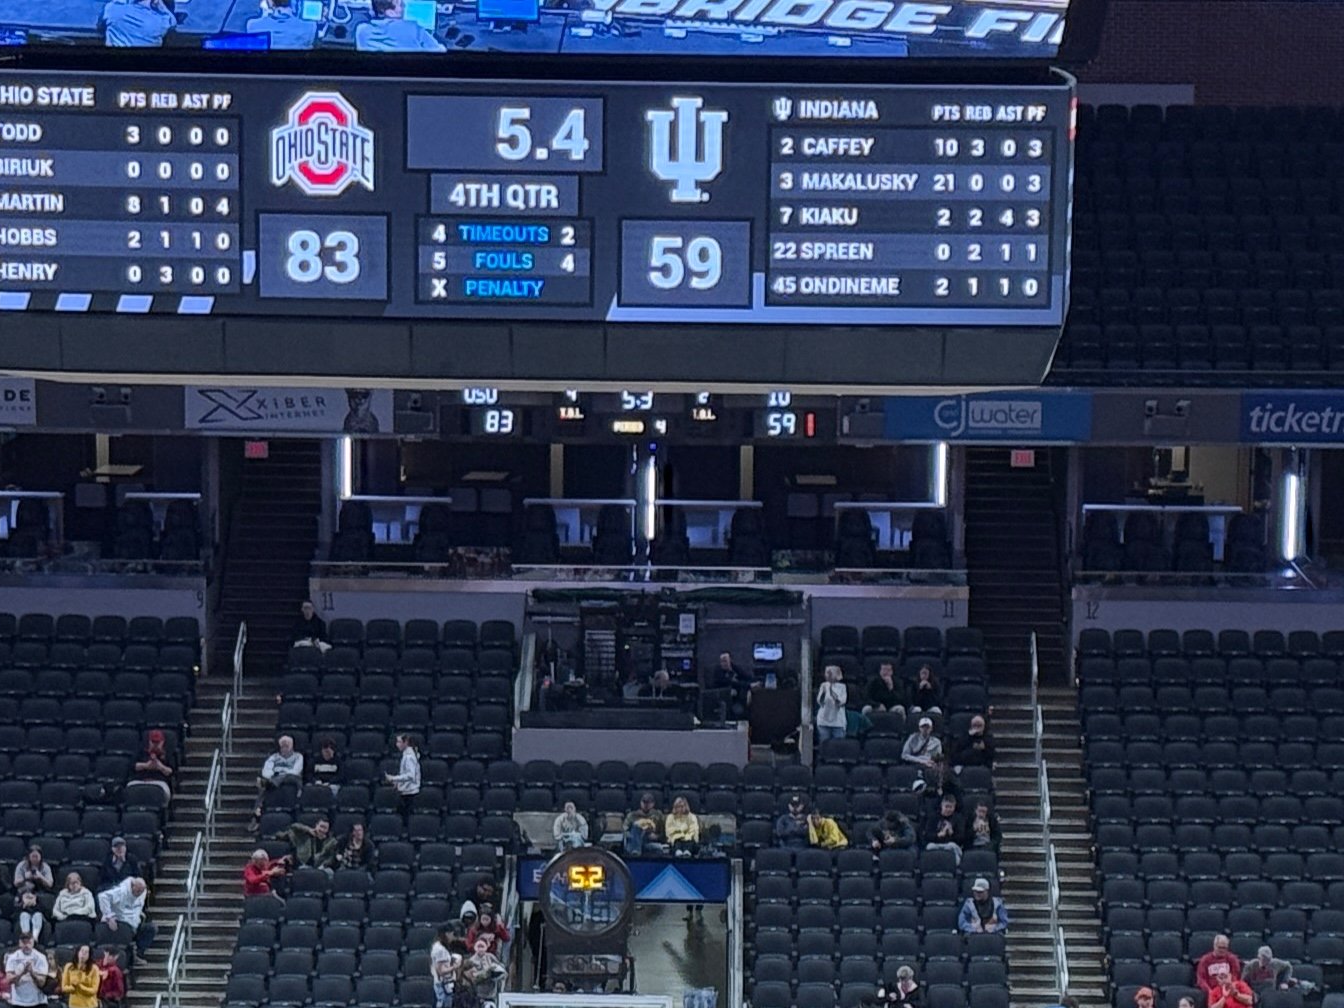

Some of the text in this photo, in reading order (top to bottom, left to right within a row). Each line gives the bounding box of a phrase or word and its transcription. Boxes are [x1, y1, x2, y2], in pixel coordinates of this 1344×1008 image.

[37, 87, 95, 106] STATE
[119, 91, 147, 109] PTS
[151, 92, 178, 109] REB
[181, 93, 210, 110] AST
[212, 93, 232, 110] PF
[799, 101, 1047, 122] INDIANA PTS REB AST PF
[126, 127, 140, 144] 3
[158, 127, 172, 144] 0
[189, 127, 203, 144] 0
[215, 127, 229, 144] 0
[496, 107, 589, 160] 5.4
[780, 138, 1042, 158] 2 CAFFEY 10 3 0 3
[127, 160, 141, 179] 0
[159, 160, 172, 179] 0
[190, 160, 204, 179] 0
[216, 160, 230, 179] 0
[779, 172, 1041, 193] 3 MAKALUSKY 21 0 0 3
[127, 196, 141, 215] 8
[159, 196, 171, 215] 1
[190, 196, 204, 215] 0
[215, 196, 230, 215] 4
[449, 183, 559, 210] 4TH QTR
[780, 207, 1041, 227] 7 KIAKU 2 2 4 3
[127, 231, 142, 249] 2
[159, 231, 171, 249] 1
[191, 231, 202, 249] 1
[217, 231, 230, 249] 0
[432, 224, 575, 245] 4 TIMEOUTS 2
[287, 230, 360, 283] 83
[432, 252, 575, 272] 5 FOULS 4
[773, 242, 1037, 262] 22 SPREEN 0 2 1 1
[649, 236, 723, 289] 59
[128, 266, 142, 284] 0
[160, 266, 174, 284] 3
[191, 266, 205, 284] 0
[217, 266, 231, 284] 0
[431, 279, 544, 297] X PENALTY
[773, 276, 1038, 296] 45 ONDINEME 2 1 1 0
[485, 410, 514, 434] 83
[971, 404, 1037, 424] water
[768, 413, 796, 436] 59
[1085, 601, 1099, 619] 12
